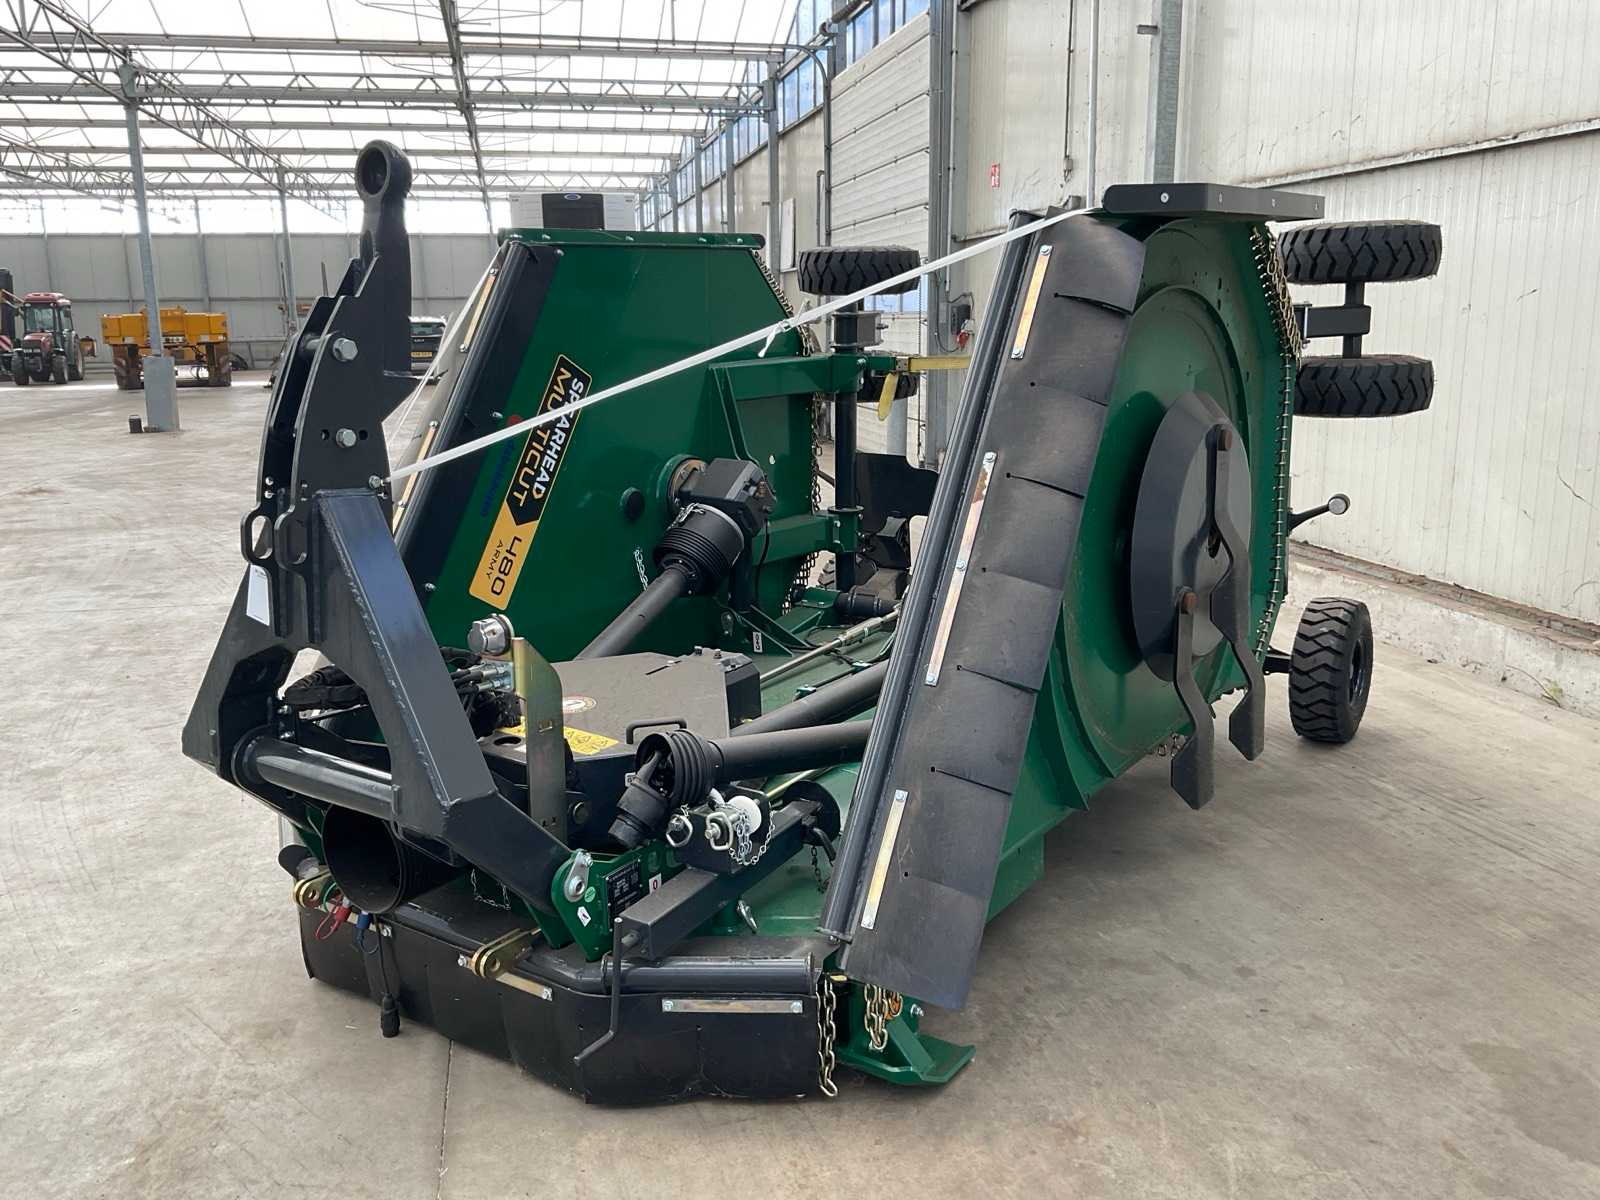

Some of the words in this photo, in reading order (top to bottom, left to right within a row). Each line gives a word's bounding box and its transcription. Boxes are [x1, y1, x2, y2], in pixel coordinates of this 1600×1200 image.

[512, 367, 572, 508] MUTICUT
[486, 538, 504, 580] ARMY
[490, 535, 522, 597] 480
